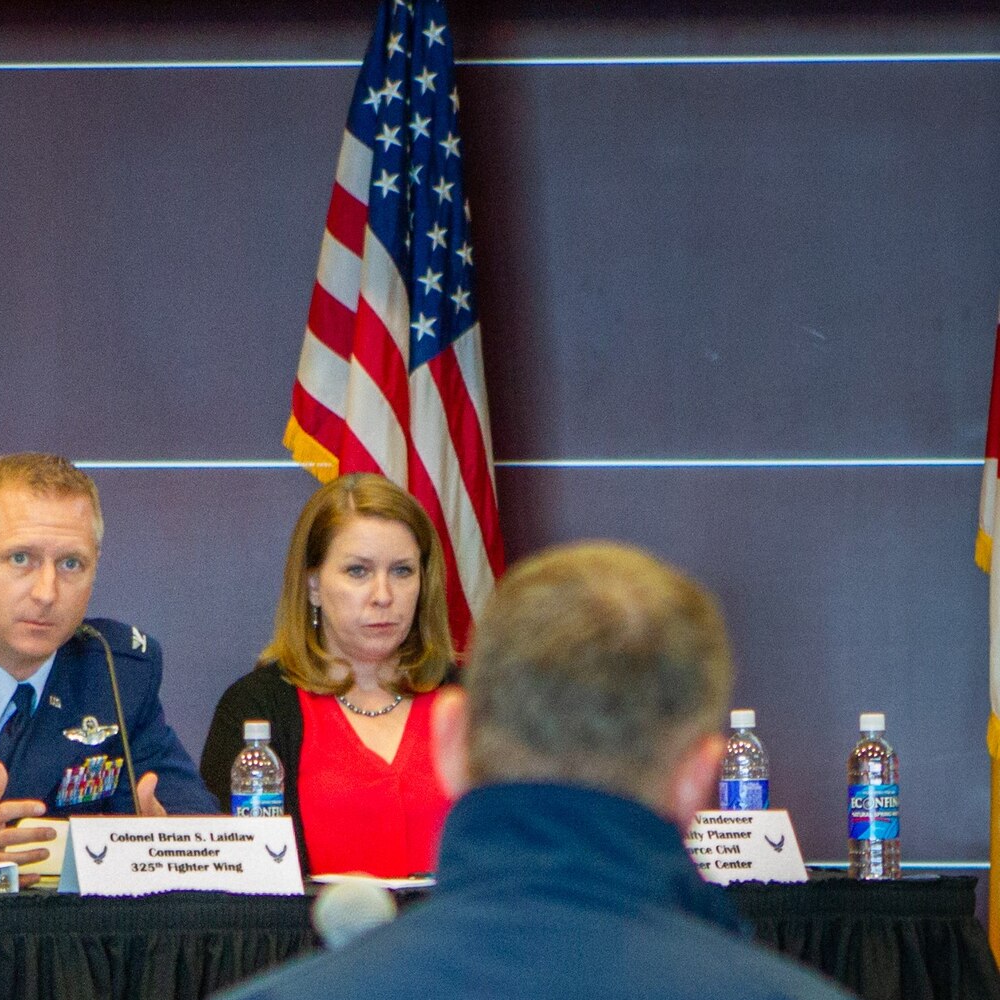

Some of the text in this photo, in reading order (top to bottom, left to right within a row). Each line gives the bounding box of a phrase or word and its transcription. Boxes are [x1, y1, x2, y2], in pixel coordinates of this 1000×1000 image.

[695, 815, 753, 825] Vandeveer
[110, 832, 255, 842] Colonel Brian S. Laidlaw
[686, 830, 752, 842] ity Planner
[148, 848, 221, 857] Commander
[688, 845, 741, 855] orce Civil
[131, 863, 244, 874] 325th Fighter Wing
[715, 860, 752, 869] Center
